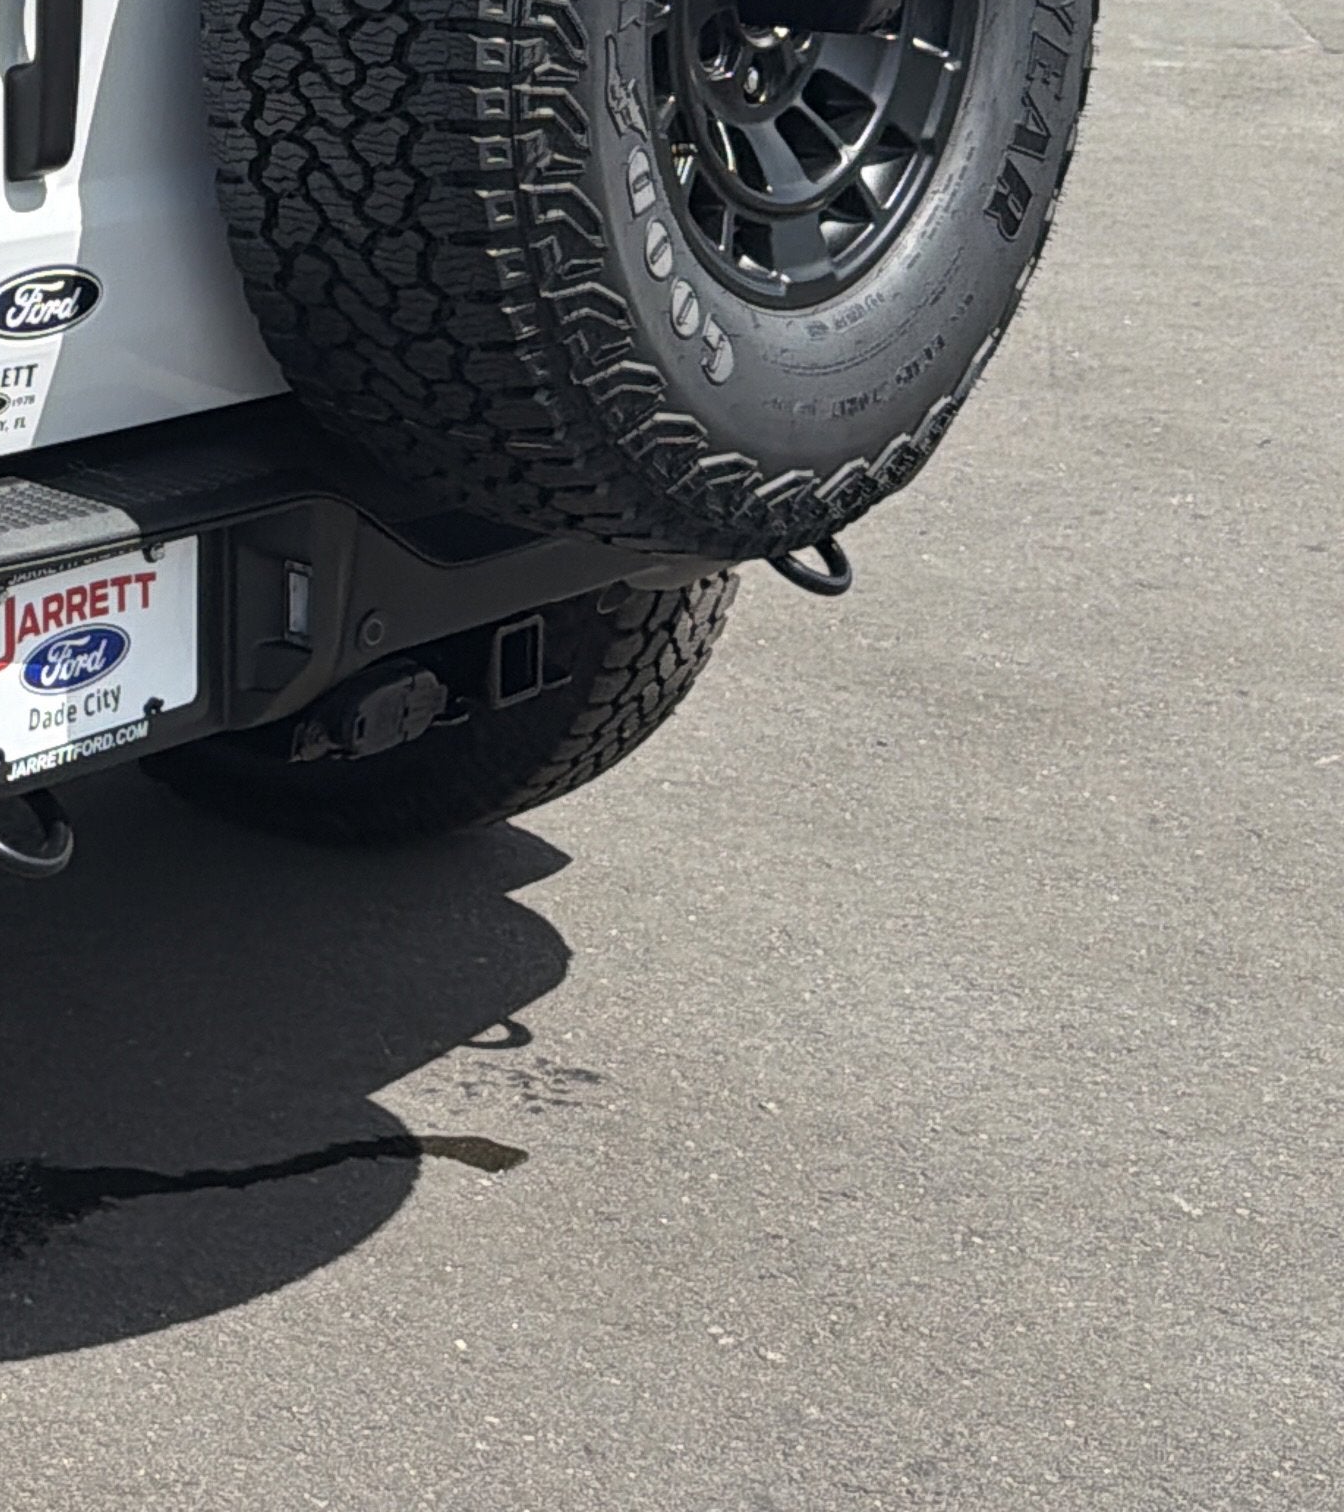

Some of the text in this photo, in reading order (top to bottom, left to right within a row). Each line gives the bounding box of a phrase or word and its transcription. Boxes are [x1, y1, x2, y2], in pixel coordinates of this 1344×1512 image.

[5, 280, 82, 328] Ford
[13, 417, 26, 430] FL
[40, 634, 108, 686] Ford
[28, 684, 122, 731] Dade City
[6, 720, 150, 782] JARRETTFORD.COM
